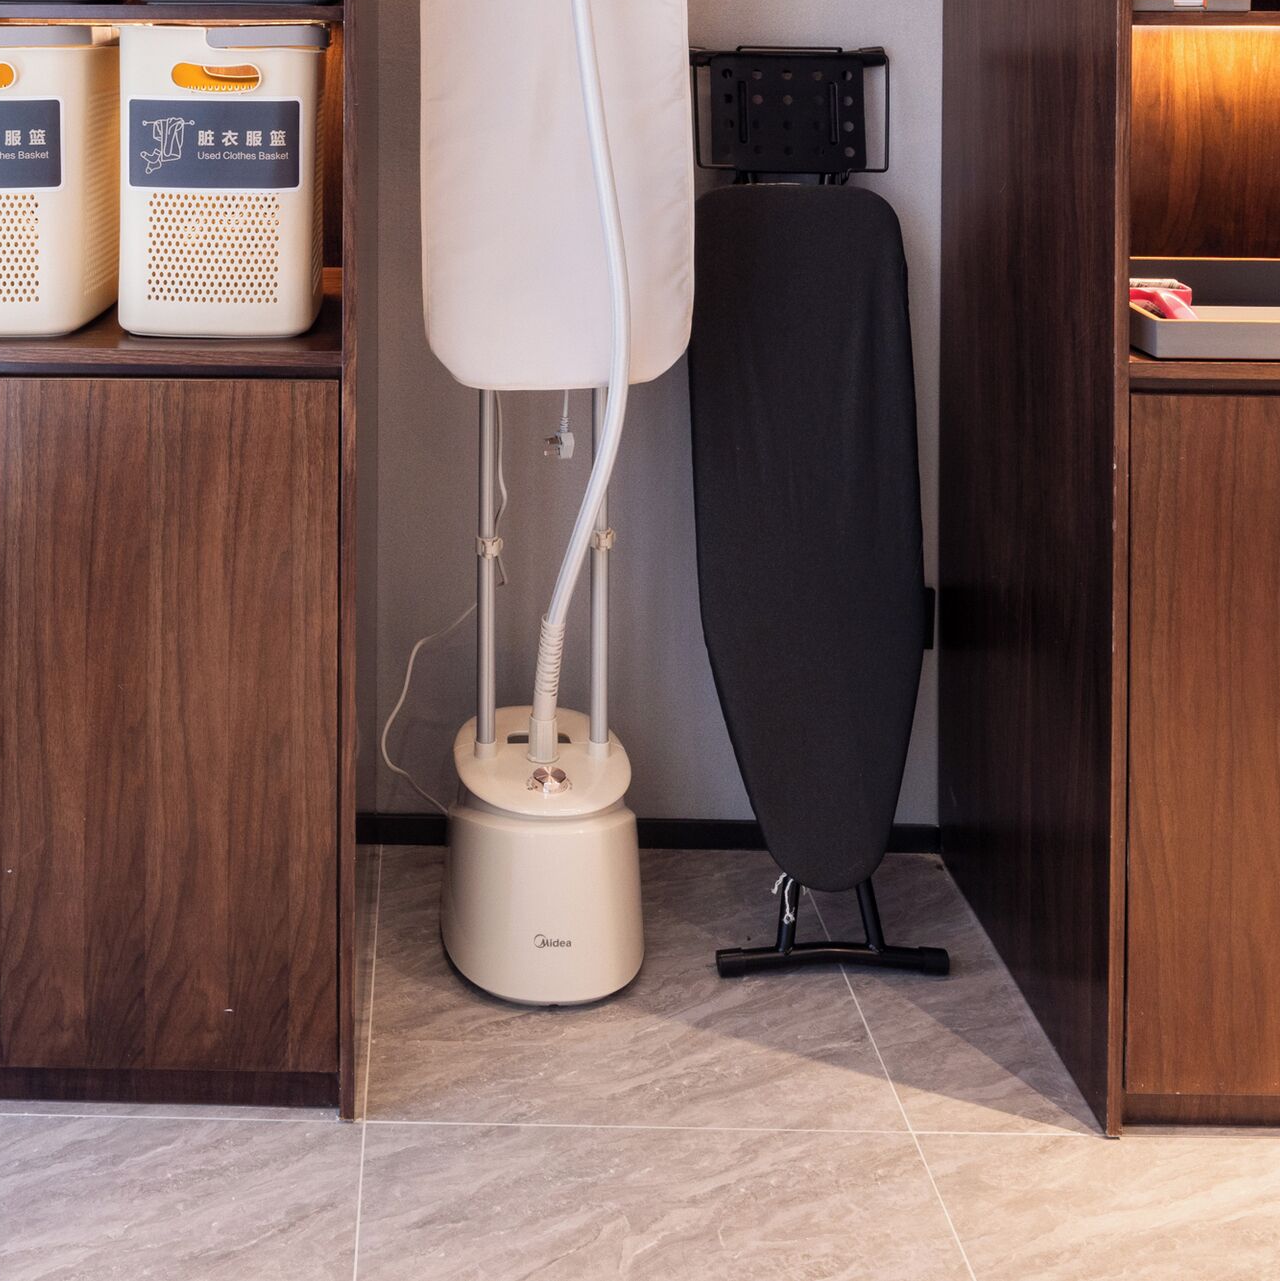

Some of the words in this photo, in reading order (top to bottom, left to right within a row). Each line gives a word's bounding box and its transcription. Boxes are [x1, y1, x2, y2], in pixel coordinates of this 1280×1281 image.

[197, 130, 287, 147] 脏衣服篮
[18, 150, 49, 160] Basket
[197, 151, 221, 160] Used
[222, 151, 256, 160] Clothes
[259, 151, 289, 160] Basket
[534, 933, 572, 948] Midea
